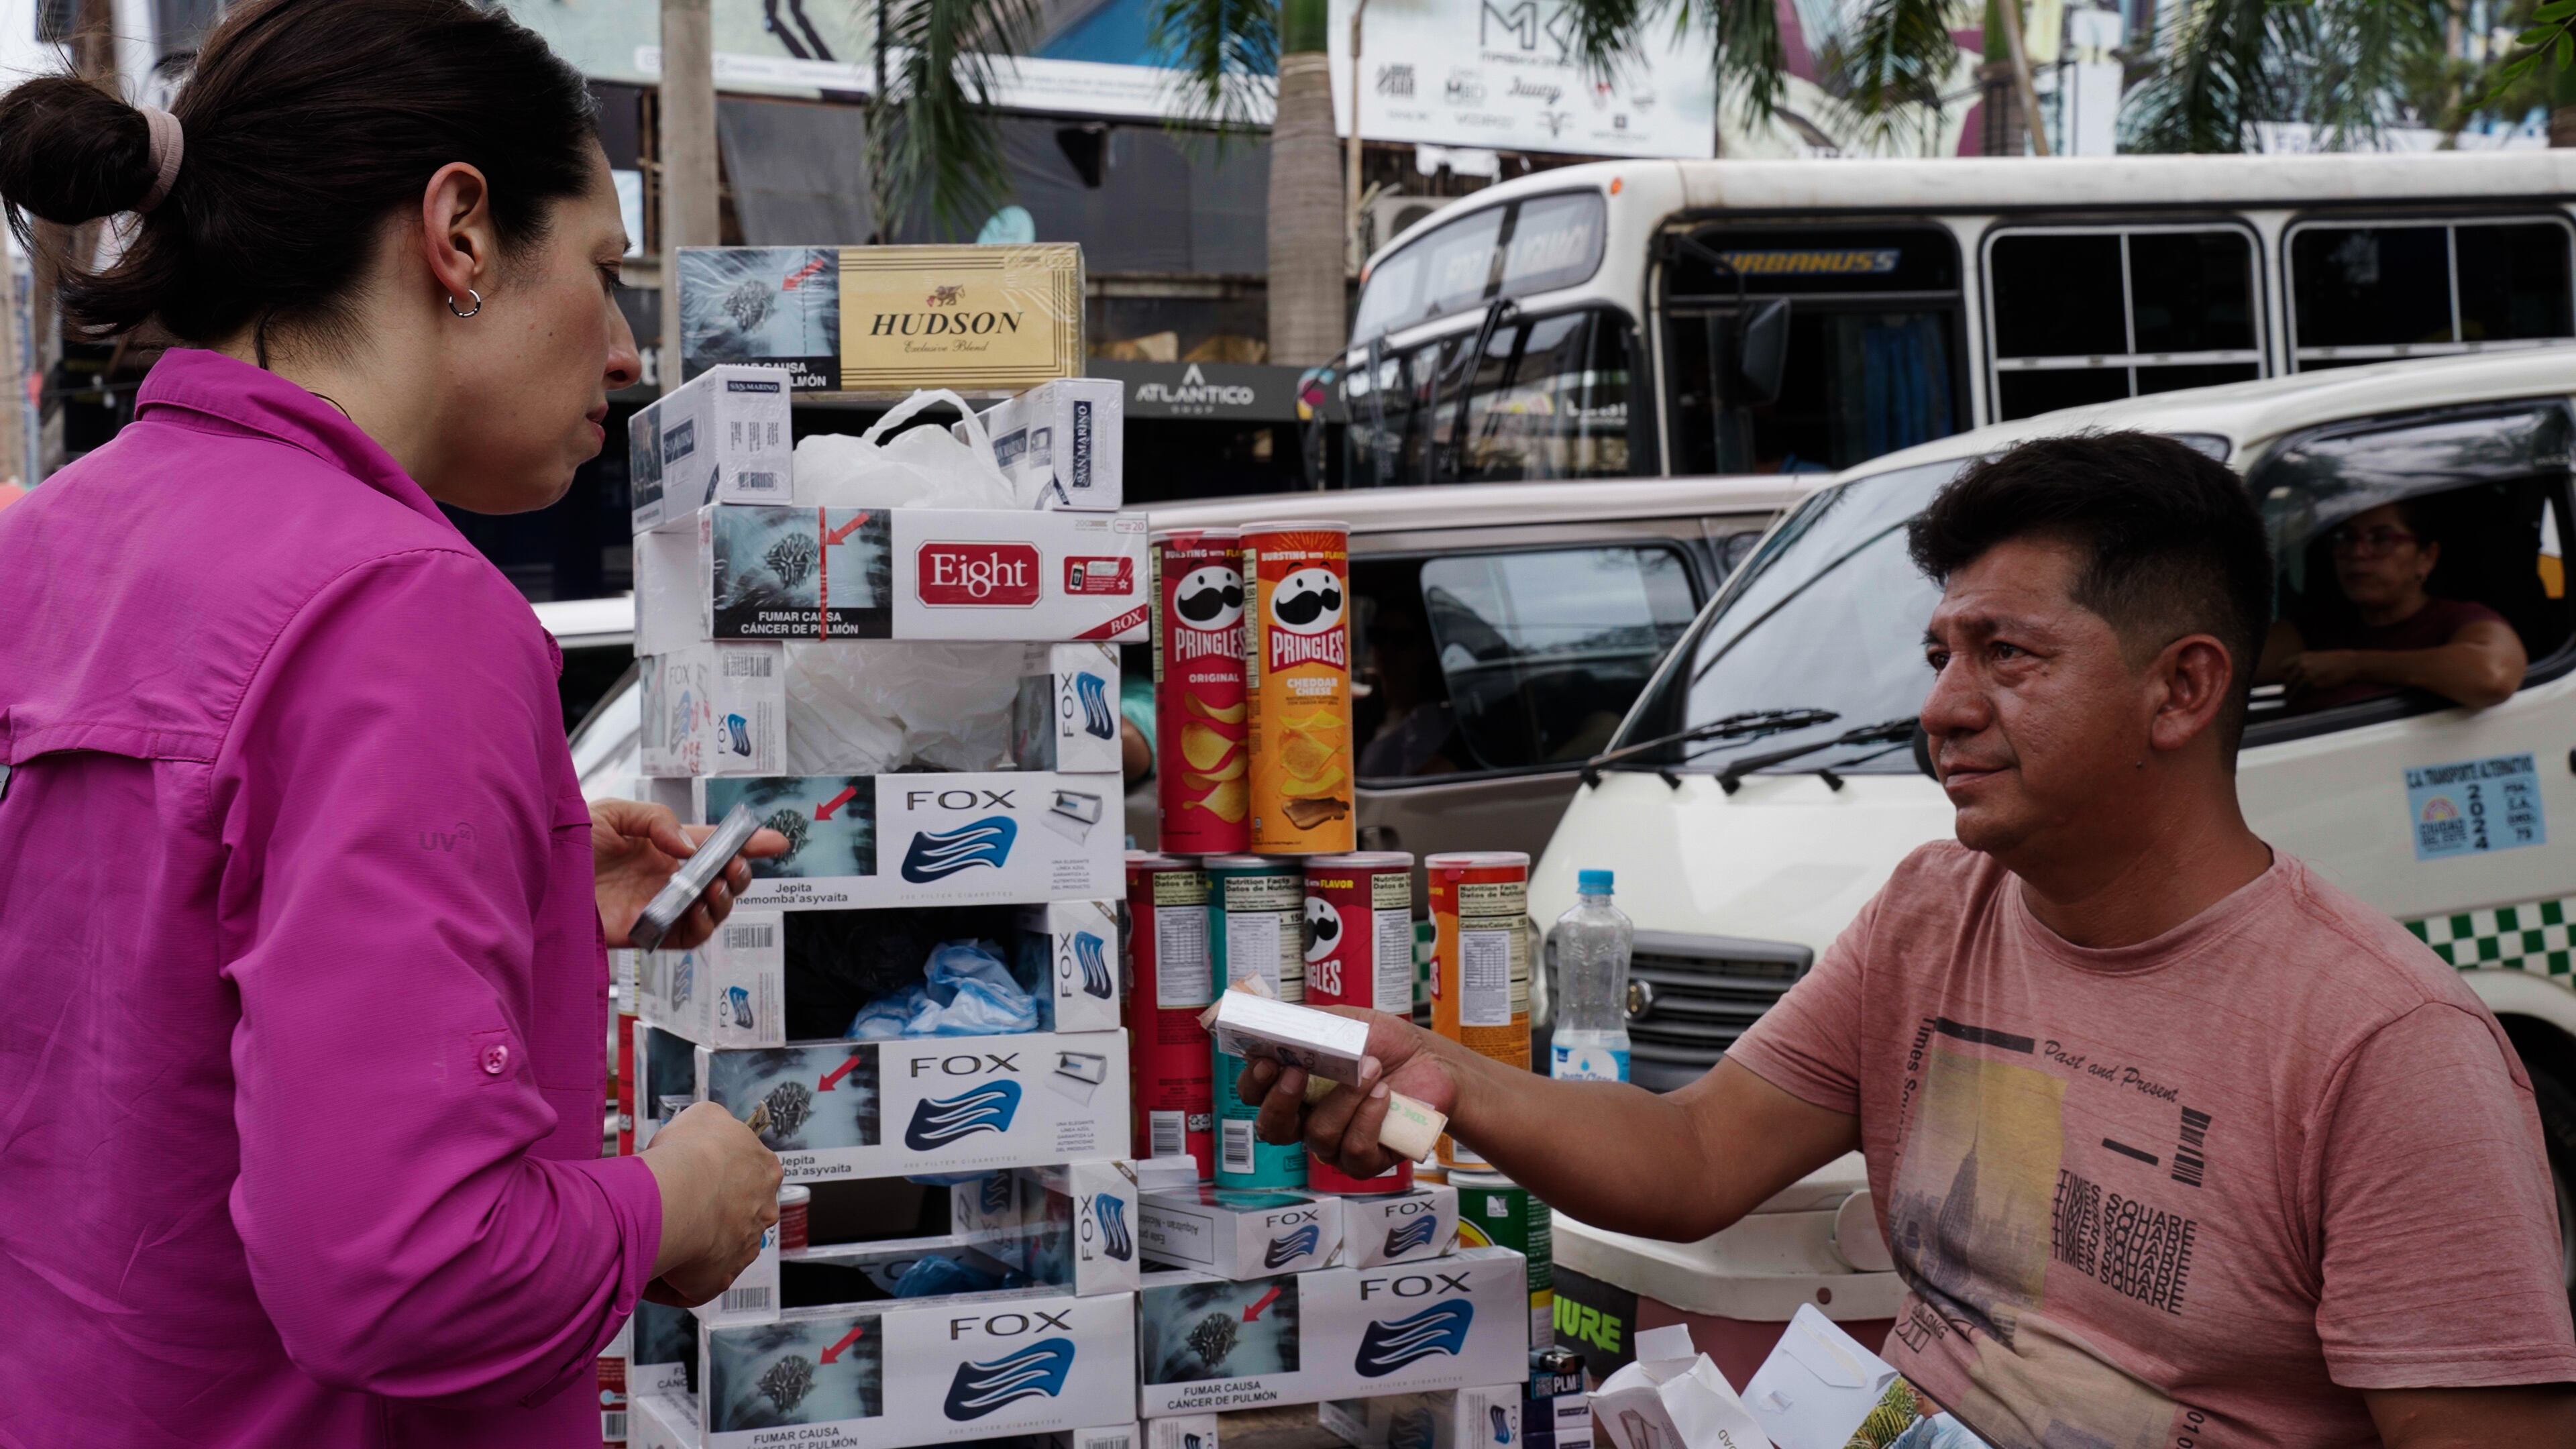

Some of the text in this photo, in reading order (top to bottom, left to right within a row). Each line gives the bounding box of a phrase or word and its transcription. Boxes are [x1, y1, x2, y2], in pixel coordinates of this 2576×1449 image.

[869, 311, 1024, 336] HUDSON
[904, 339, 989, 353] Exclusive Blend
[747, 383, 778, 392] MARINO
[790, 375, 827, 387] LMÓN
[1135, 382, 1254, 405] ATLANTICO
[1076, 405, 1088, 484] SAN MARINO
[1132, 522, 1144, 531] 20
[1261, 551, 1307, 561] BURSTING
[1308, 551, 1324, 559] WITH
[930, 551, 1028, 598] Eight
[759, 611, 799, 622] FUMAR
[1110, 610, 1142, 635] BOX
[741, 621, 789, 634] CÁNCER
[792, 624, 807, 634] DE
[1175, 627, 1246, 663] PRINGLES
[1271, 629, 1344, 667] PRINGLES
[1189, 673, 1240, 684] ORIGINAL
[1287, 678, 1338, 688] CHEDDAR
[1295, 687, 1332, 696] CHEESE
[1061, 672, 1075, 737] FOX
[717, 714, 727, 755] FOX
[907, 789, 1016, 810] FOX
[1320, 879, 1354, 889] FLAVOR
[1373, 874, 1403, 882] Nutrition
[775, 883, 812, 894] Jepita
[1225, 884, 1250, 892] Datos
[1060, 931, 1073, 998] FOX
[1308, 959, 1342, 997] GLES
[718, 987, 729, 1028] FOX
[1907, 1017, 1937, 1072] Times
[910, 1053, 1020, 1078] FOX
[2045, 1040, 2180, 1104] Past and Present
[780, 1155, 816, 1167] Jepita
[961, 1155, 1018, 1165] CIGARETTES
[1385, 1199, 1436, 1218] FOX
[2061, 1169, 2197, 1235] TIMES SQUARE
[1081, 1194, 1093, 1261] FOX
[1266, 1209, 1319, 1228] FOX
[1360, 1271, 1472, 1301] FOX
[2052, 1242, 2182, 1316] TIMES SQUARE
[950, 1309, 1073, 1340] FOX
[657, 1375, 687, 1389] CÁNC
[1184, 1381, 1261, 1397] FUMAR CAUSA
[1412, 1376, 1463, 1386] CIGARETTES
[1167, 1391, 1278, 1410] CÁNCER DE PULMÓN
[1006, 1418, 1063, 1430] CIGARETTES
[2182, 1411, 2205, 1434] 01
[754, 1427, 840, 1444] FUMAR CAUSA
[808, 1437, 857, 1449] PULMÓN
